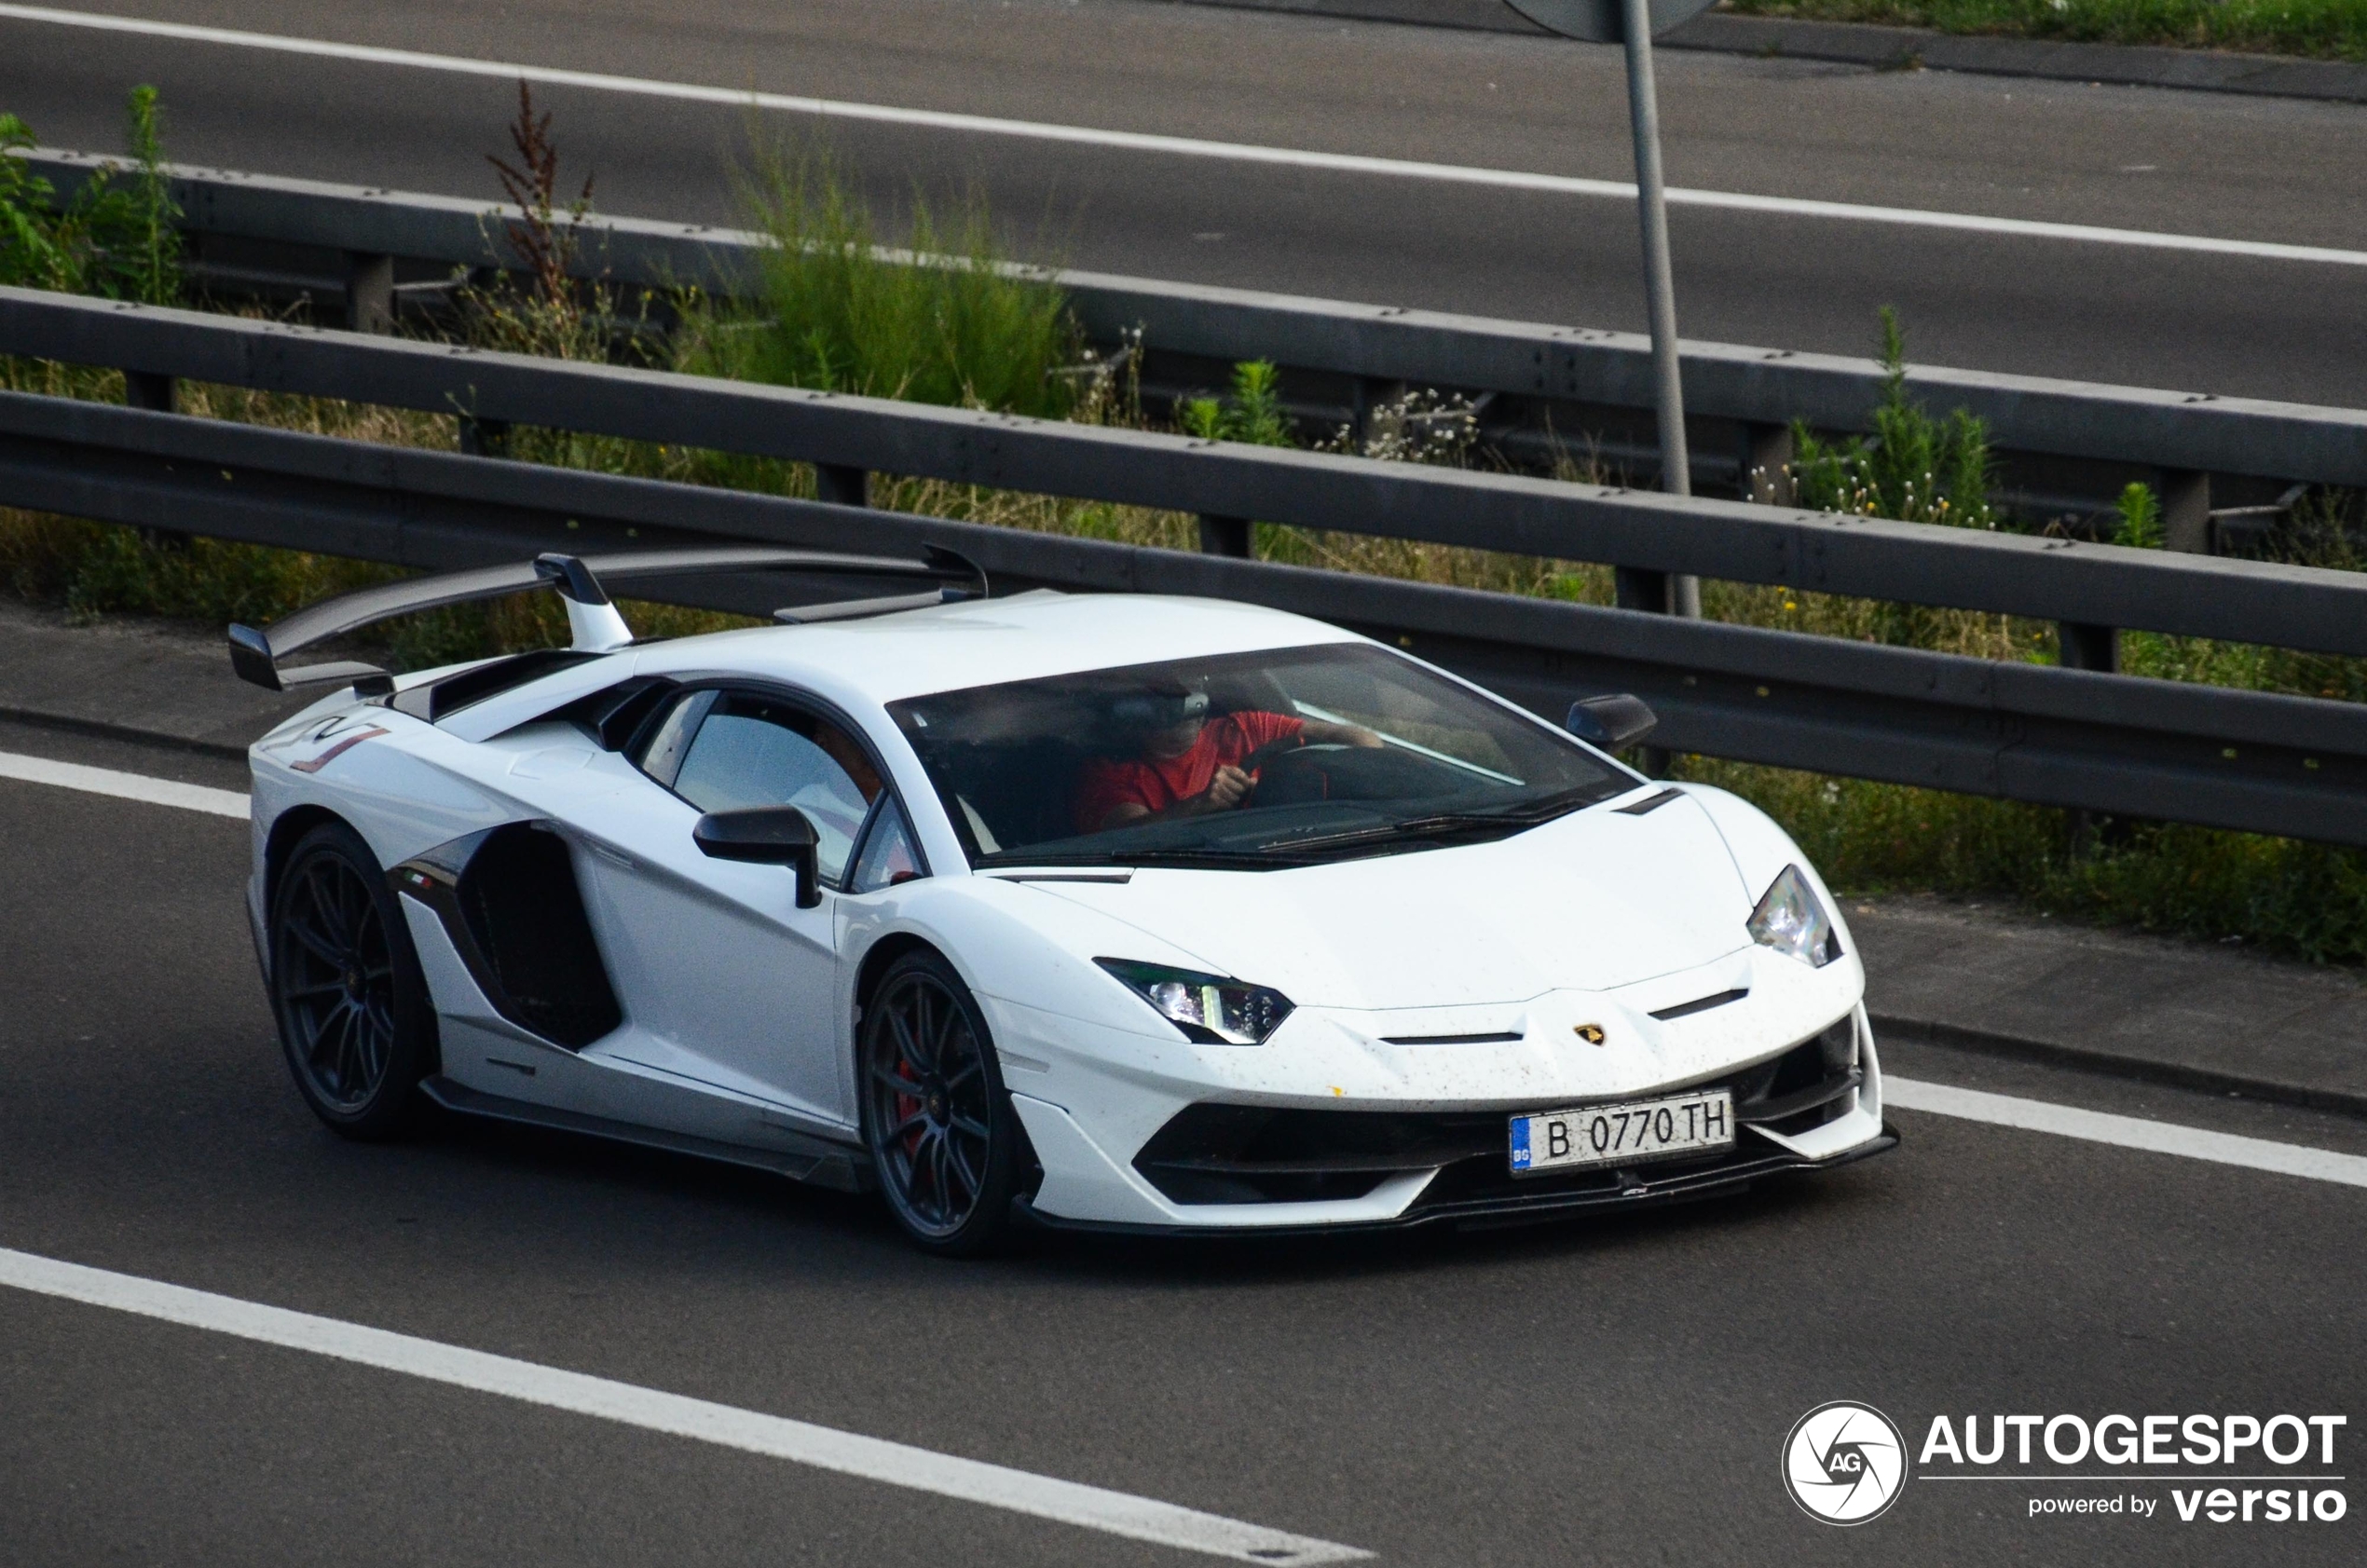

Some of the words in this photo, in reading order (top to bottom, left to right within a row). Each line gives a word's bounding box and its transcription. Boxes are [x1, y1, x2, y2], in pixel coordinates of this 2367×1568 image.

[1549, 1121, 1570, 1158] B
[1591, 1107, 1673, 1152] 0770
[1681, 1099, 1725, 1140] TH
